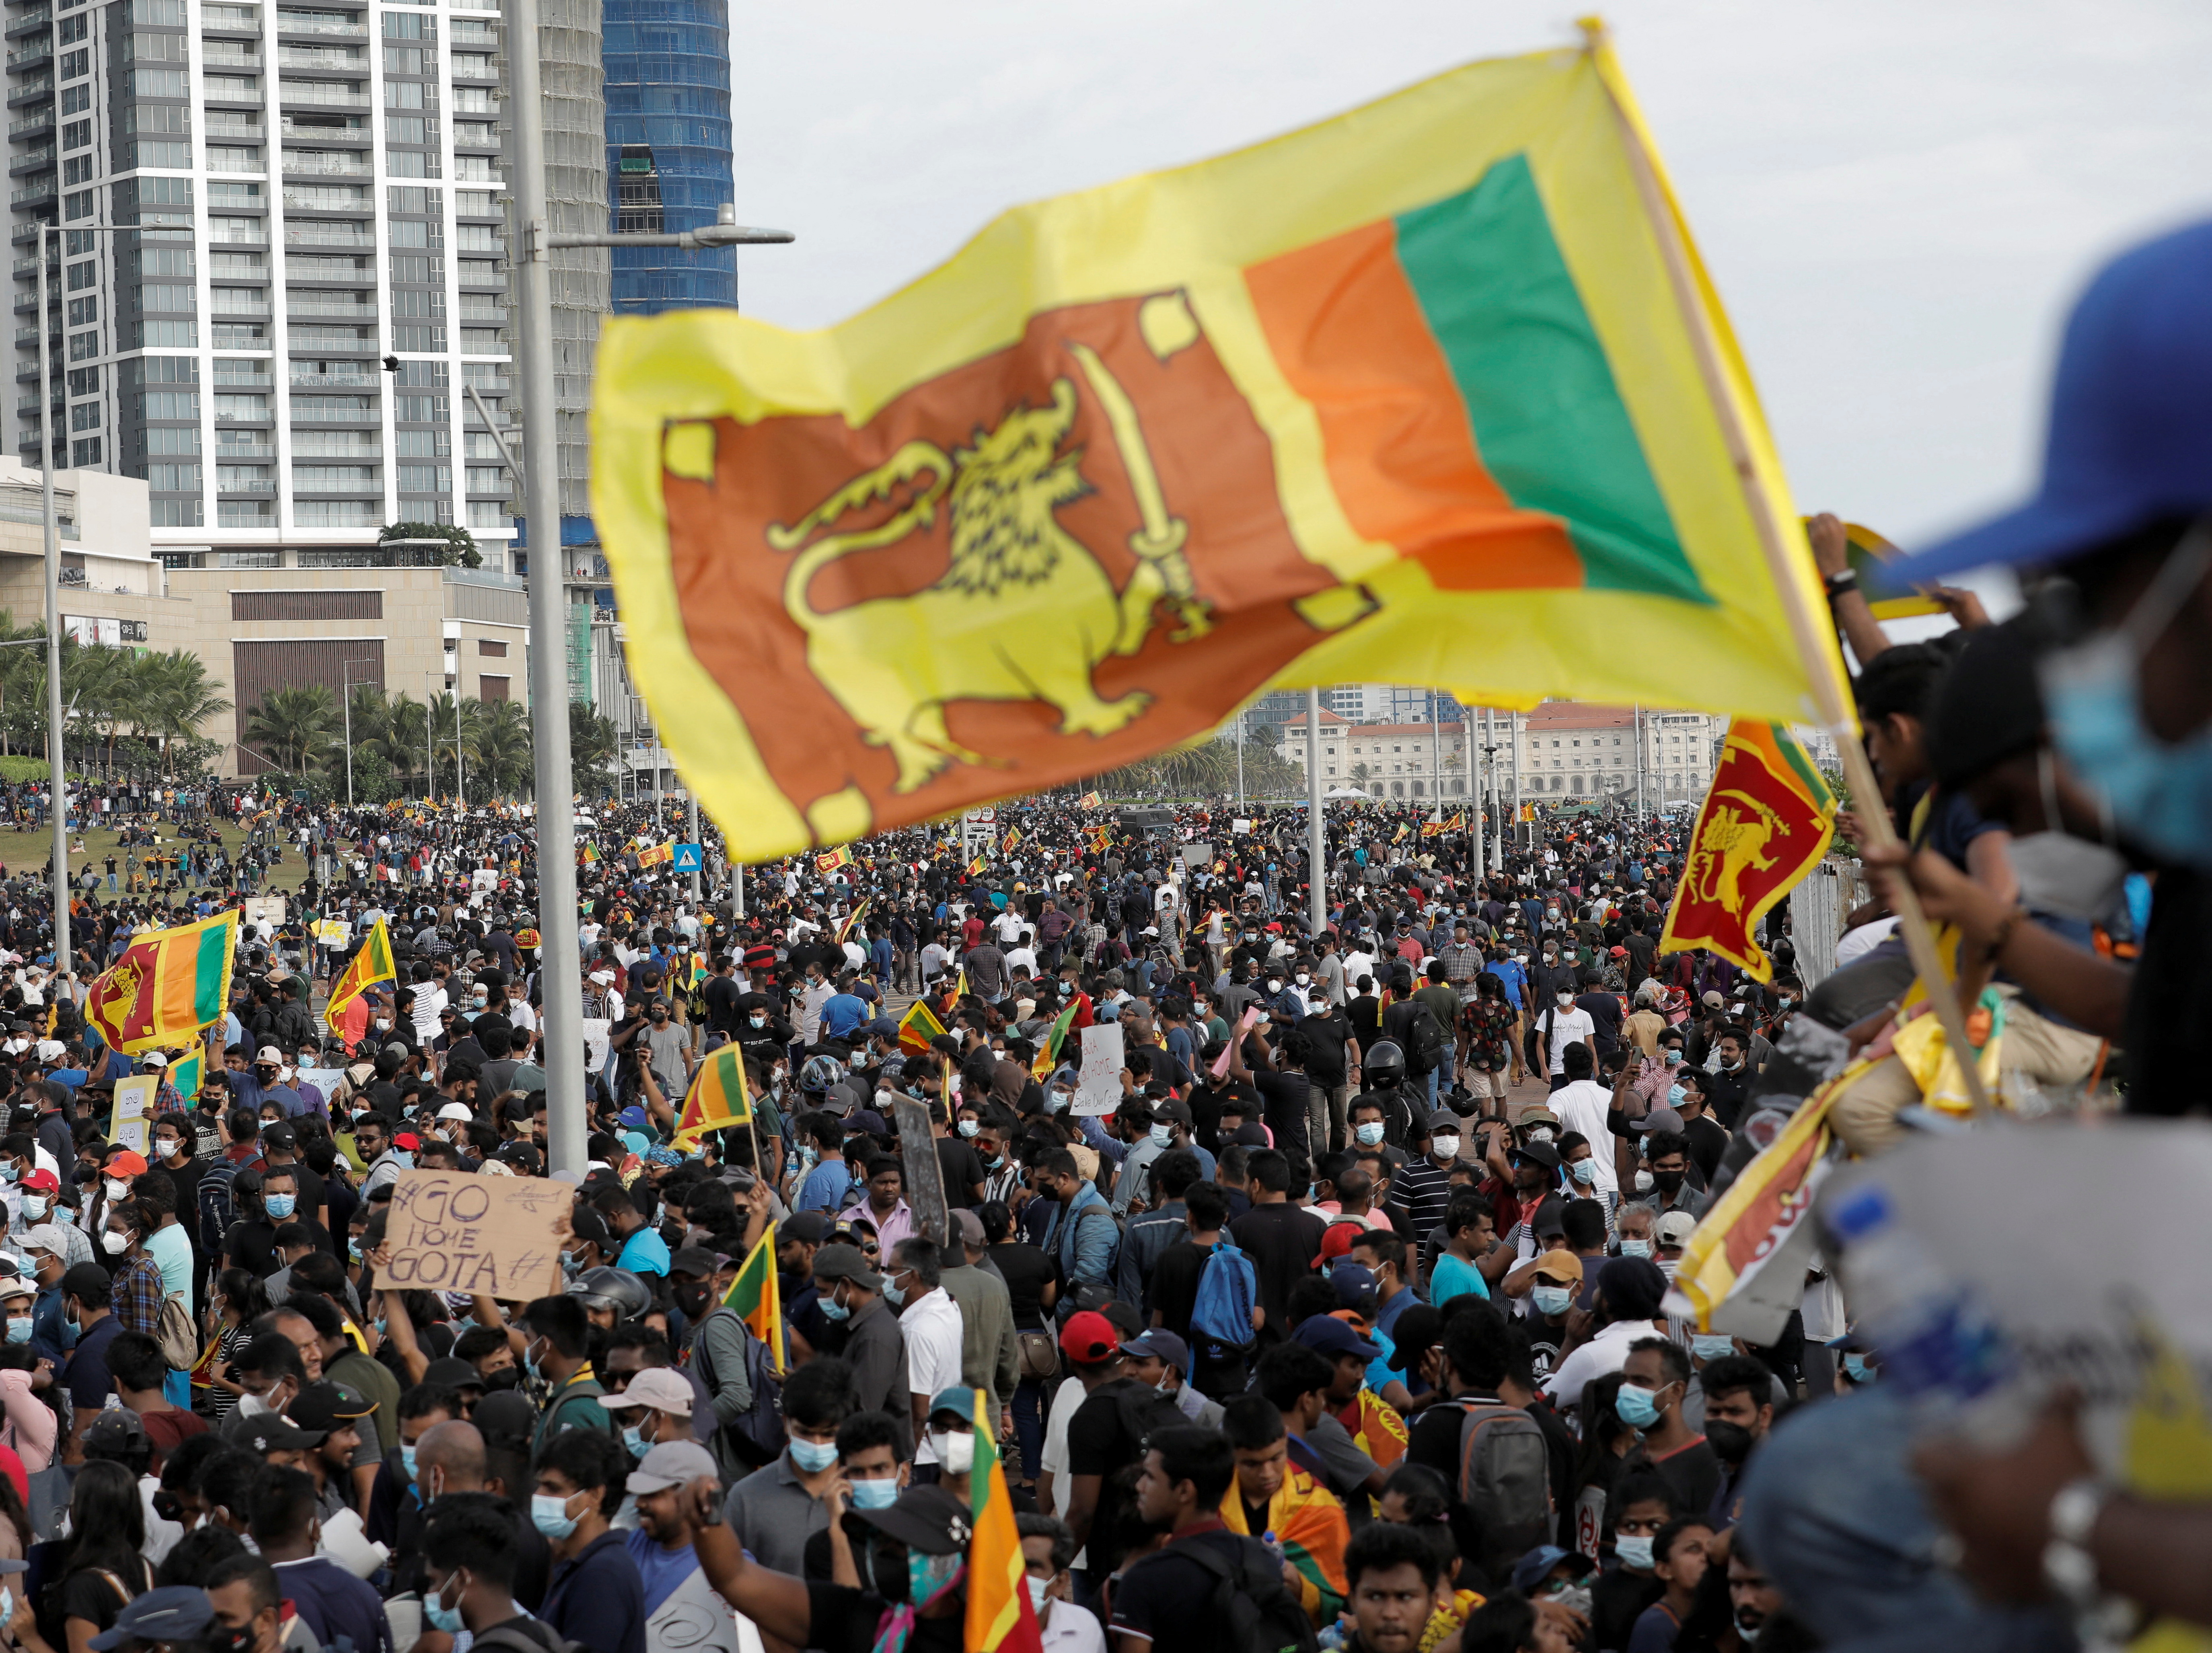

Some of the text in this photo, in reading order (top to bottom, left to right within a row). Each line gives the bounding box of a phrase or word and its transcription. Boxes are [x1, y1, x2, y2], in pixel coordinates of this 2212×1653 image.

[121, 625, 134, 635] ODEL
[138, 623, 147, 639] PVR
[1091, 1058, 1114, 1077] HOME
[325, 1073, 342, 1086] and
[125, 1093, 139, 1105] නම
[119, 1128, 135, 1141] වැඩ
[392, 1179, 489, 1225] #GO
[213, 1205, 223, 1232] Columbia
[407, 1223, 482, 1248] HOME
[1241, 1289, 1253, 1329] adidas
